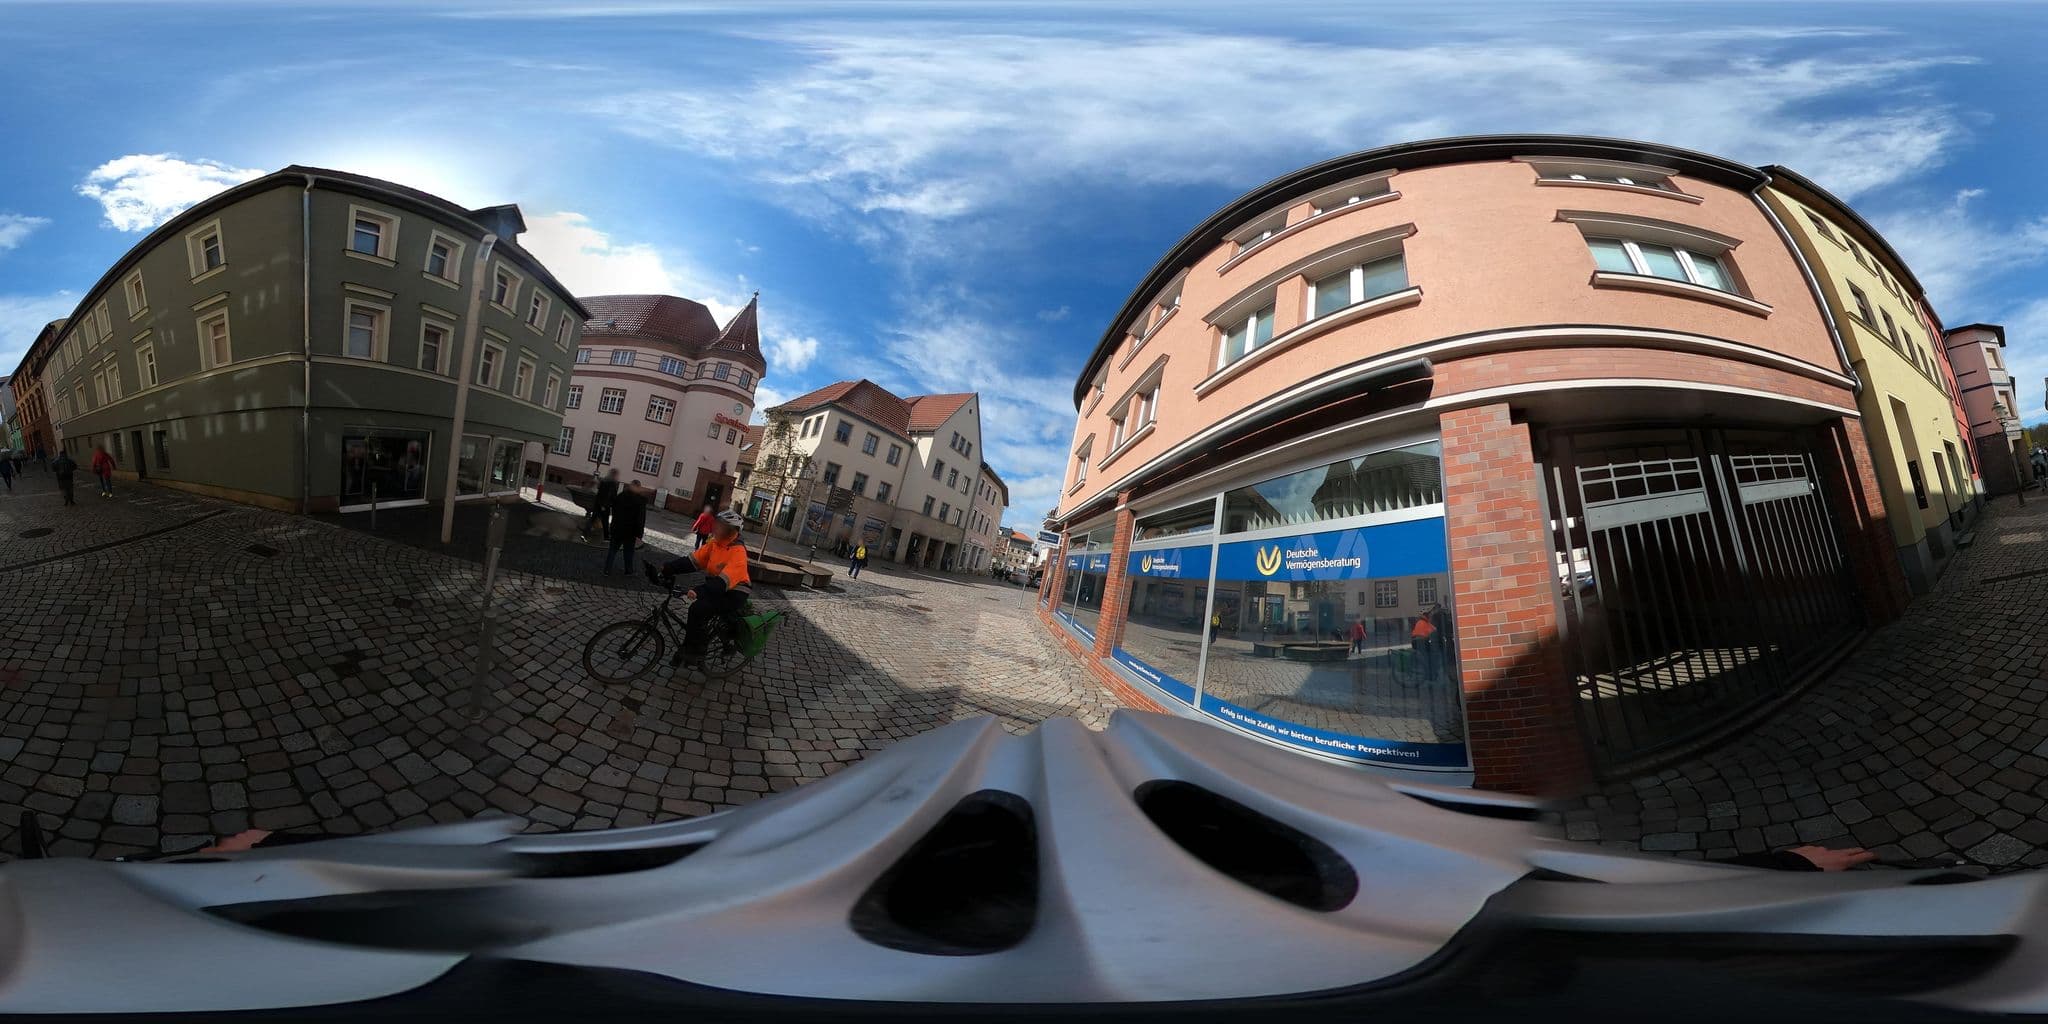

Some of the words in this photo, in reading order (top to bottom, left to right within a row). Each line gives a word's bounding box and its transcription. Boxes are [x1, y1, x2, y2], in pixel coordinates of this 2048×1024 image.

[1286, 548, 1318, 559] Deutsche
[1286, 557, 1360, 571] Vermögensberatung
[1220, 707, 1235, 719] Erfolg
[1244, 716, 1256, 725] kein
[1257, 720, 1277, 733] Zufall,
[1278, 727, 1289, 735] wir
[1290, 730, 1313, 742] bieten
[1315, 736, 1356, 751] berufliche
[1358, 744, 1420, 758] Perspektiven!
